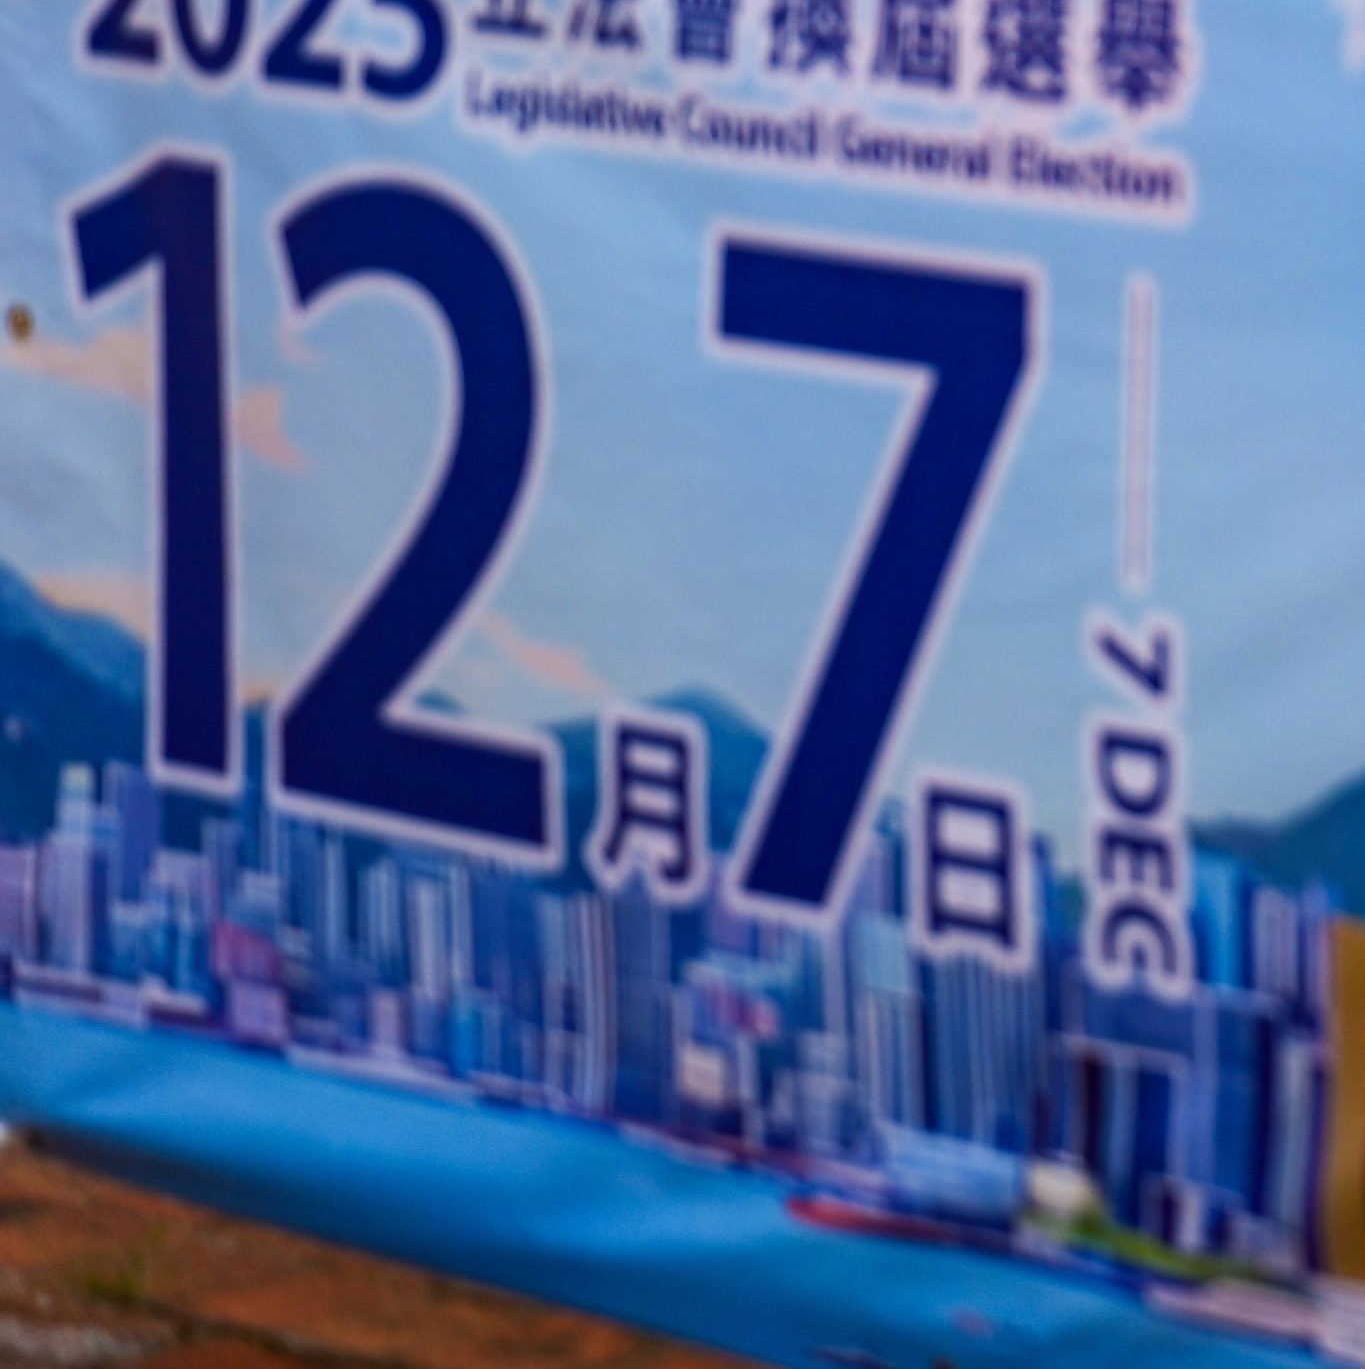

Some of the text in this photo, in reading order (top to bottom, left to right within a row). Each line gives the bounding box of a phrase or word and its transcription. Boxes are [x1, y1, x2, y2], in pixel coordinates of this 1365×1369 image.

[468, 76, 1172, 201] Legislative Council General Election
[71, 155, 1040, 951] 12月7日
[1096, 627, 1180, 991] 7 DEC
